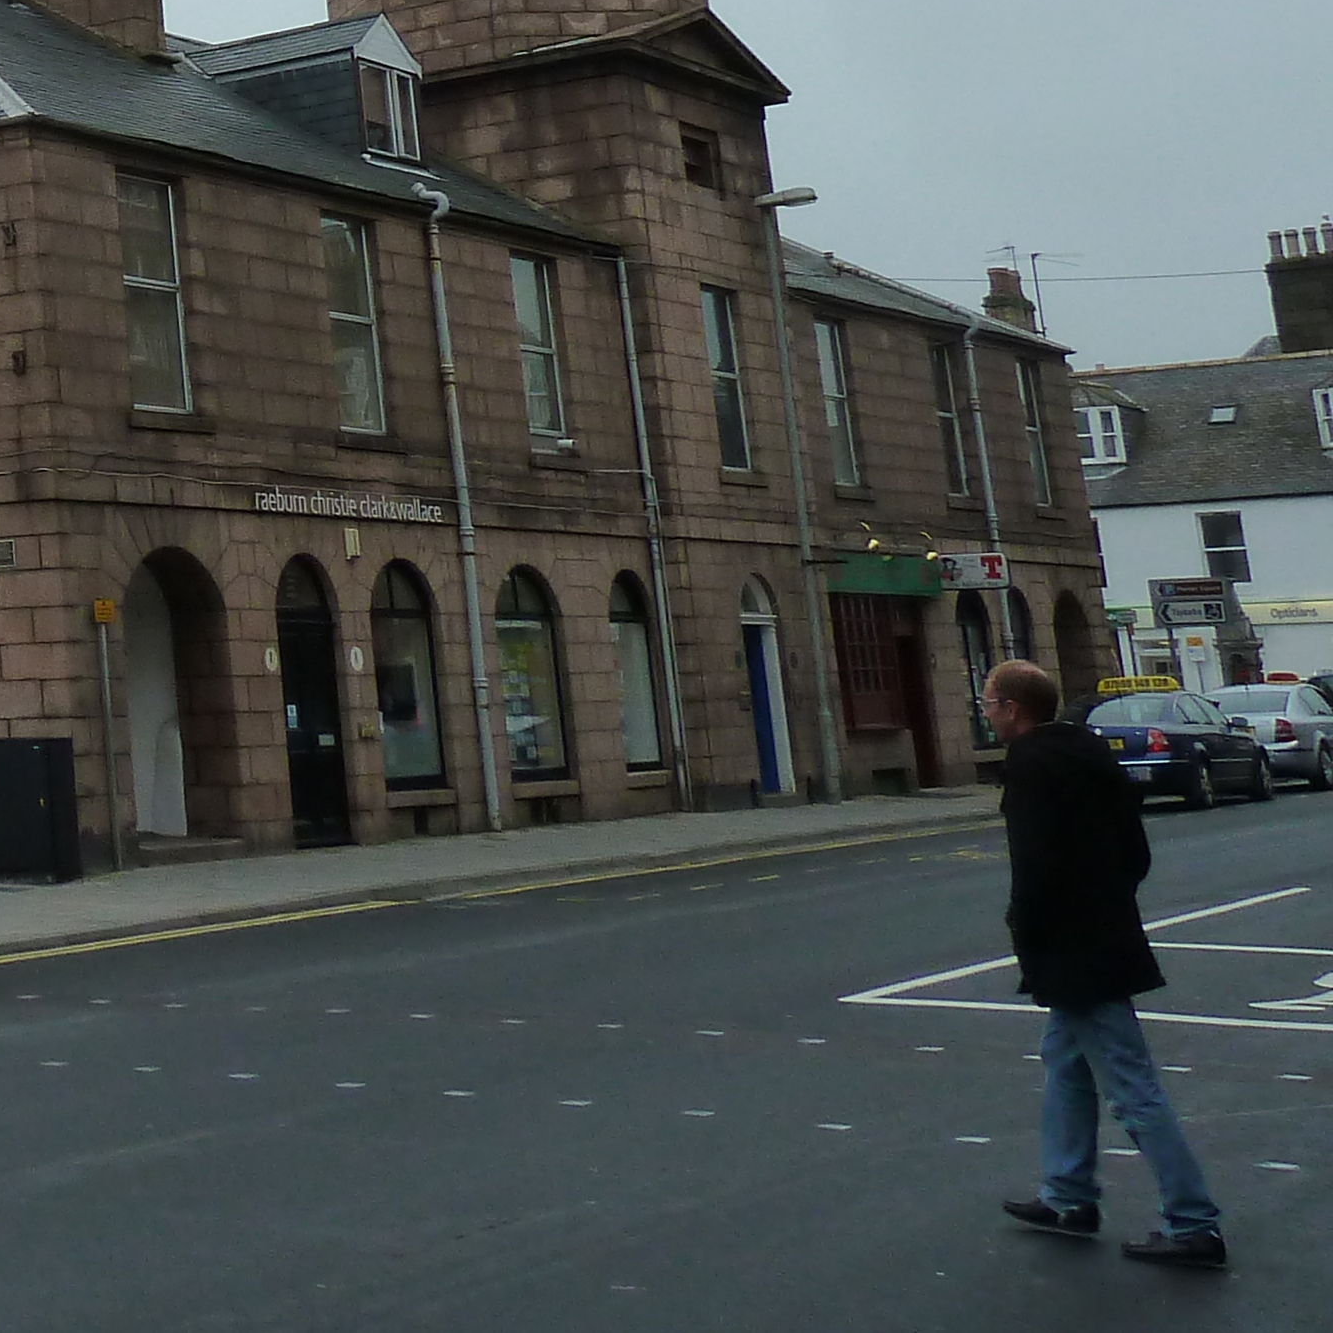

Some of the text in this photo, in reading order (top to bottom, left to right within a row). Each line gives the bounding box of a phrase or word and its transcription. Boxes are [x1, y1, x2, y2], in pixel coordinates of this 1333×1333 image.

[255, 486, 308, 513] raeburn
[311, 491, 357, 517] christie
[1270, 607, 1319, 619] Opticians
